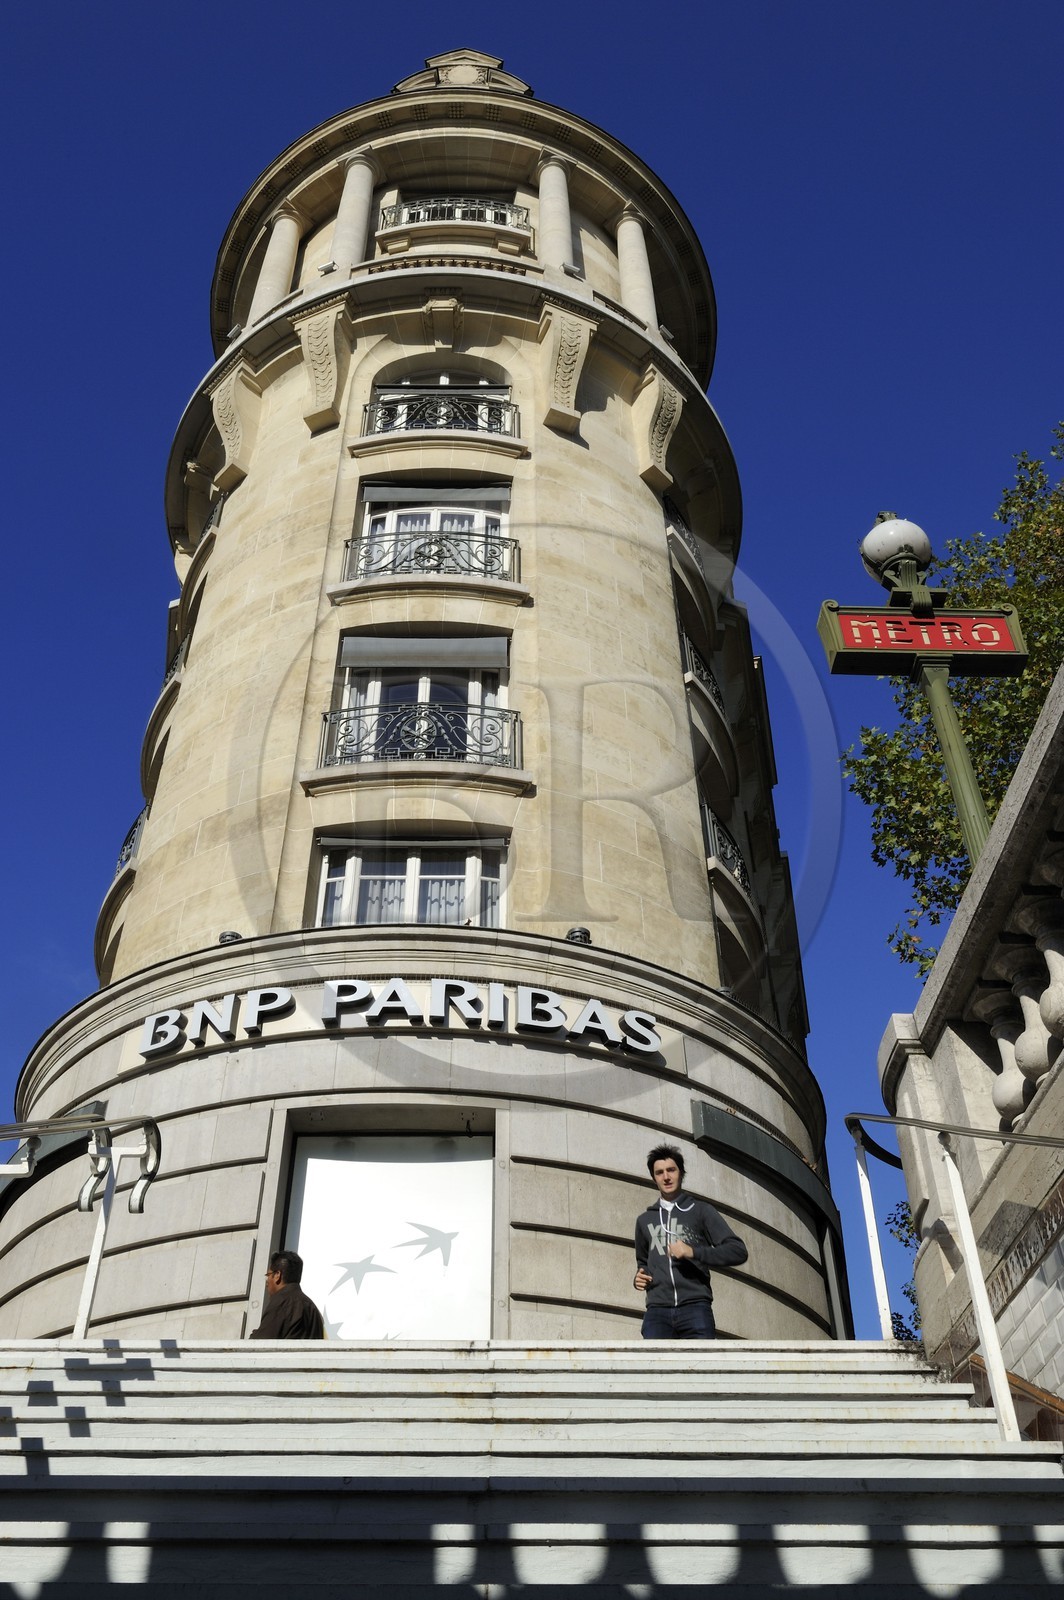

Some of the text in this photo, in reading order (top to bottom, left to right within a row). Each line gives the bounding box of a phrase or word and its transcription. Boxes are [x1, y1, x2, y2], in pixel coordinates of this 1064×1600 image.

[850, 620, 1001, 646] METRO
[138, 977, 662, 1058] BNP PARIBAS
